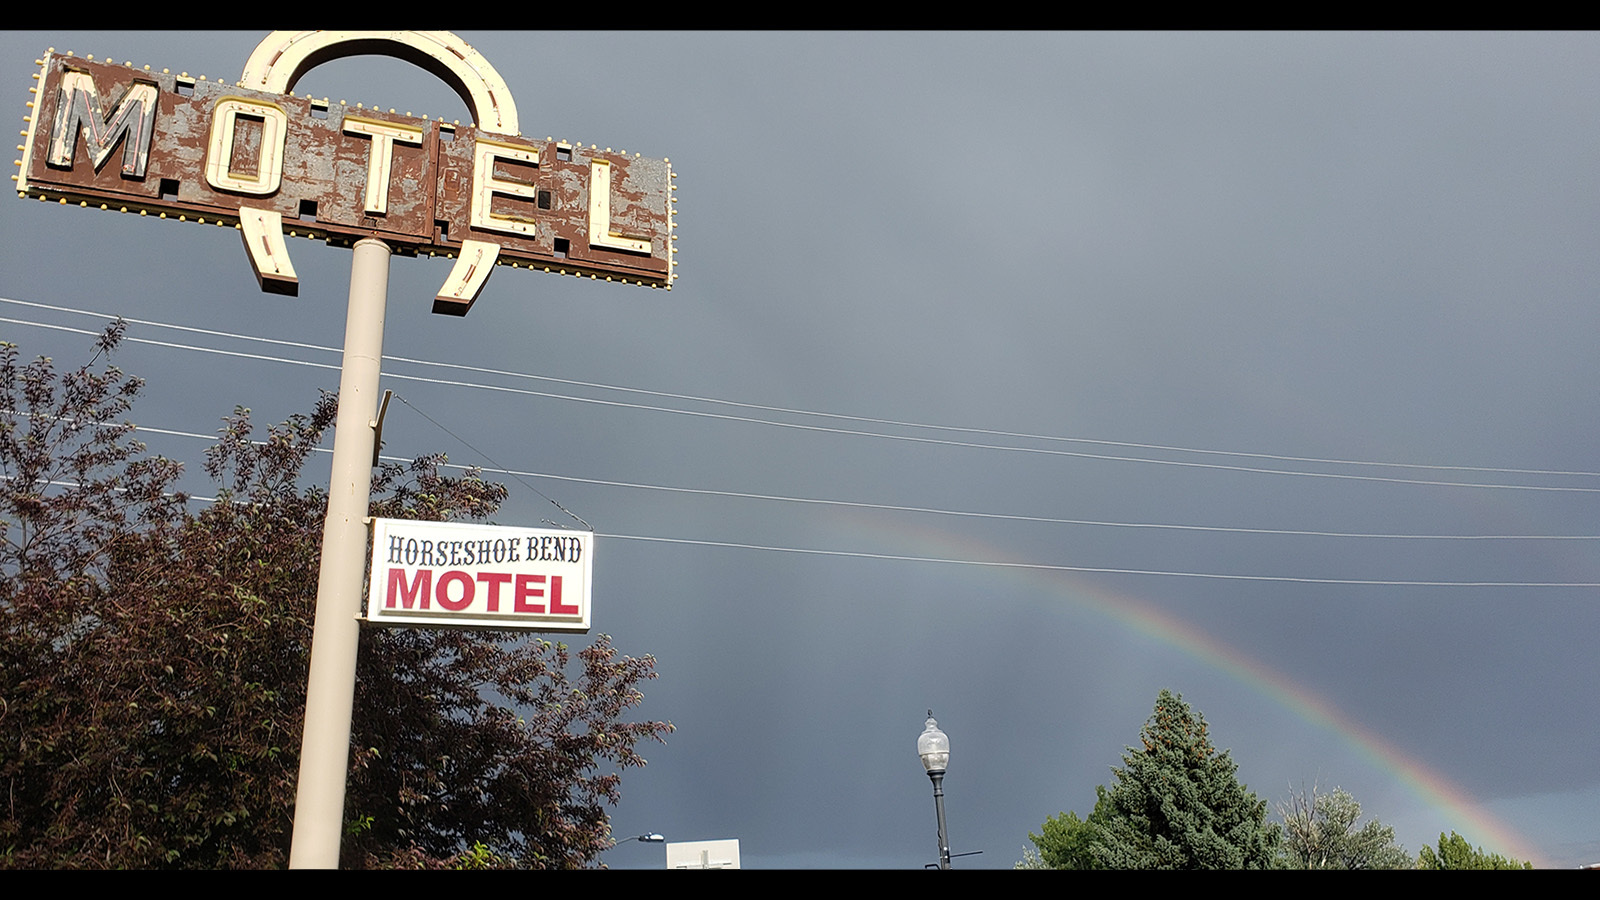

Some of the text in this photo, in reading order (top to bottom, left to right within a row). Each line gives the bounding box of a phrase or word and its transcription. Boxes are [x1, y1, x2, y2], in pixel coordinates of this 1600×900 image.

[46, 67, 652, 254] MOTEL
[387, 534, 582, 566] HORSESHOE BEND
[385, 568, 579, 615] MOTEL
